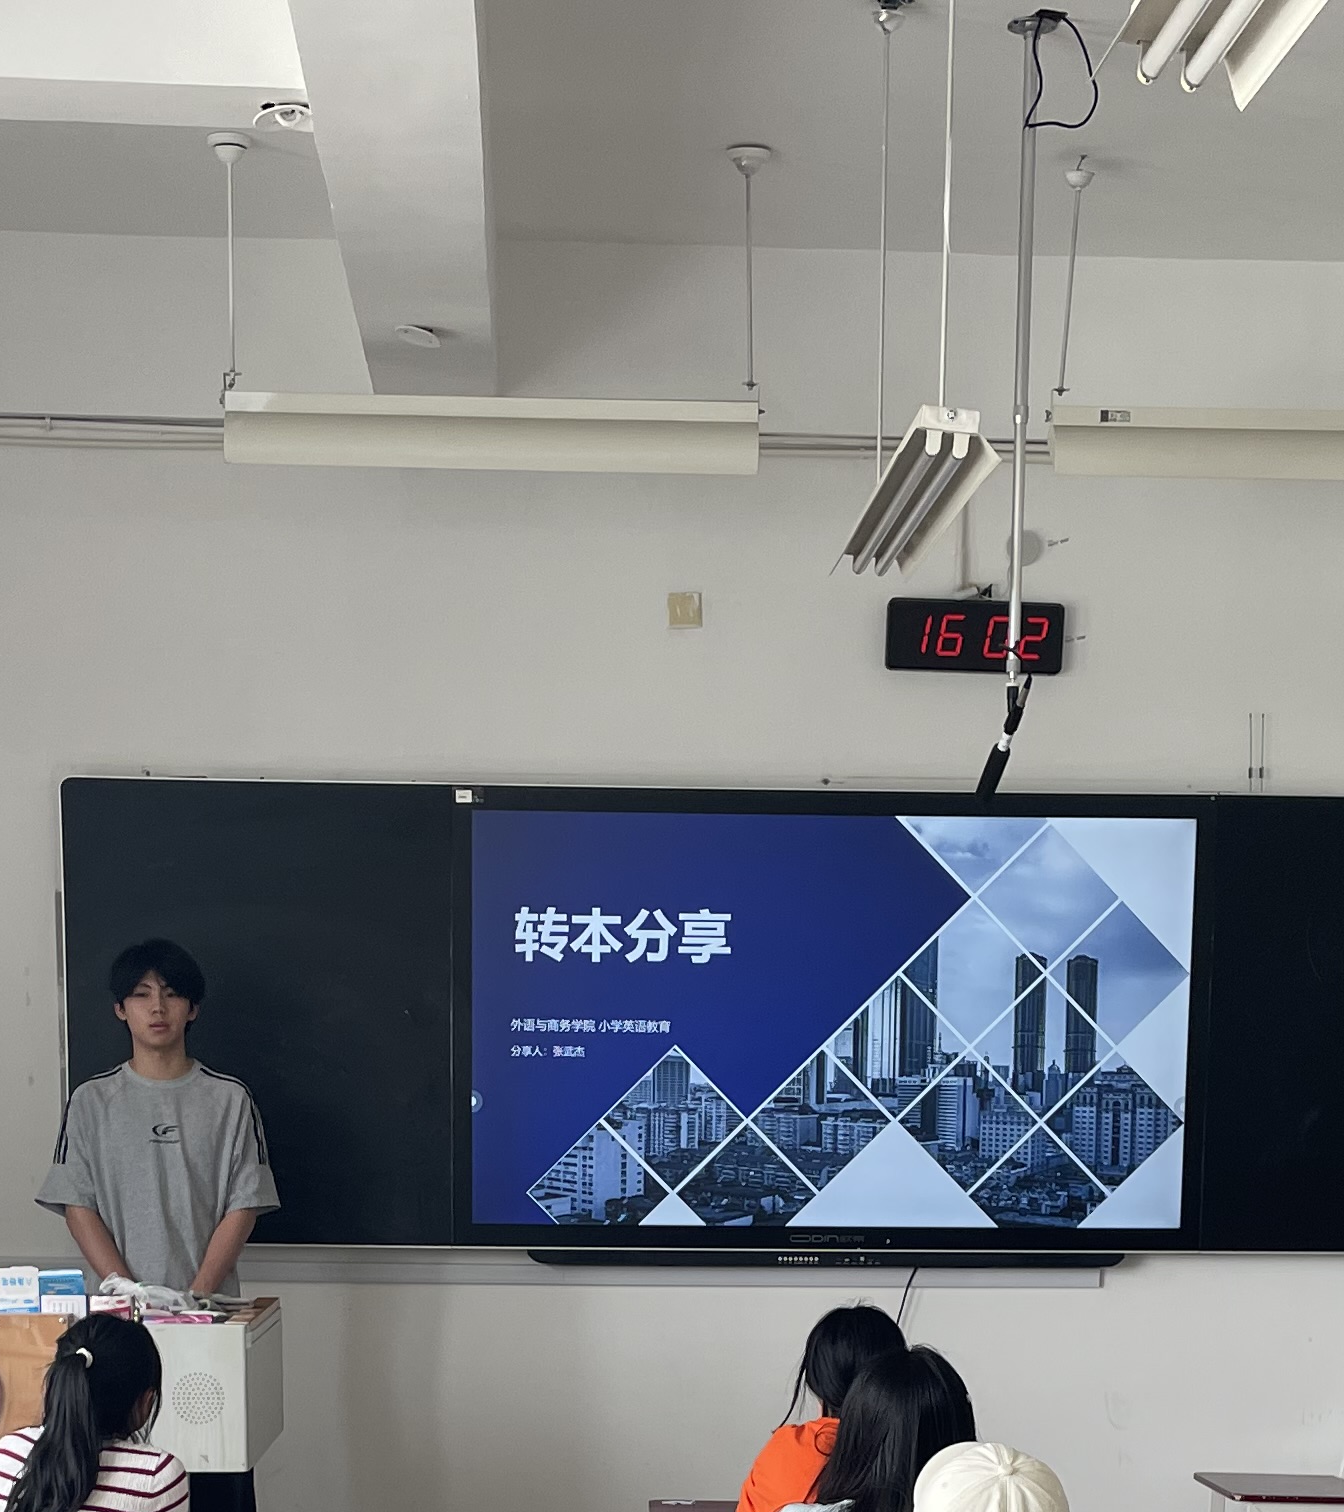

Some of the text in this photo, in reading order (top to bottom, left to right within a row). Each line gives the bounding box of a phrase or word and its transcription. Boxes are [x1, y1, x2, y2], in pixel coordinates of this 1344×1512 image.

[514, 906, 732, 964] 转本分享
[510, 1018, 672, 1034] 外语与商务学院 小学英语教育
